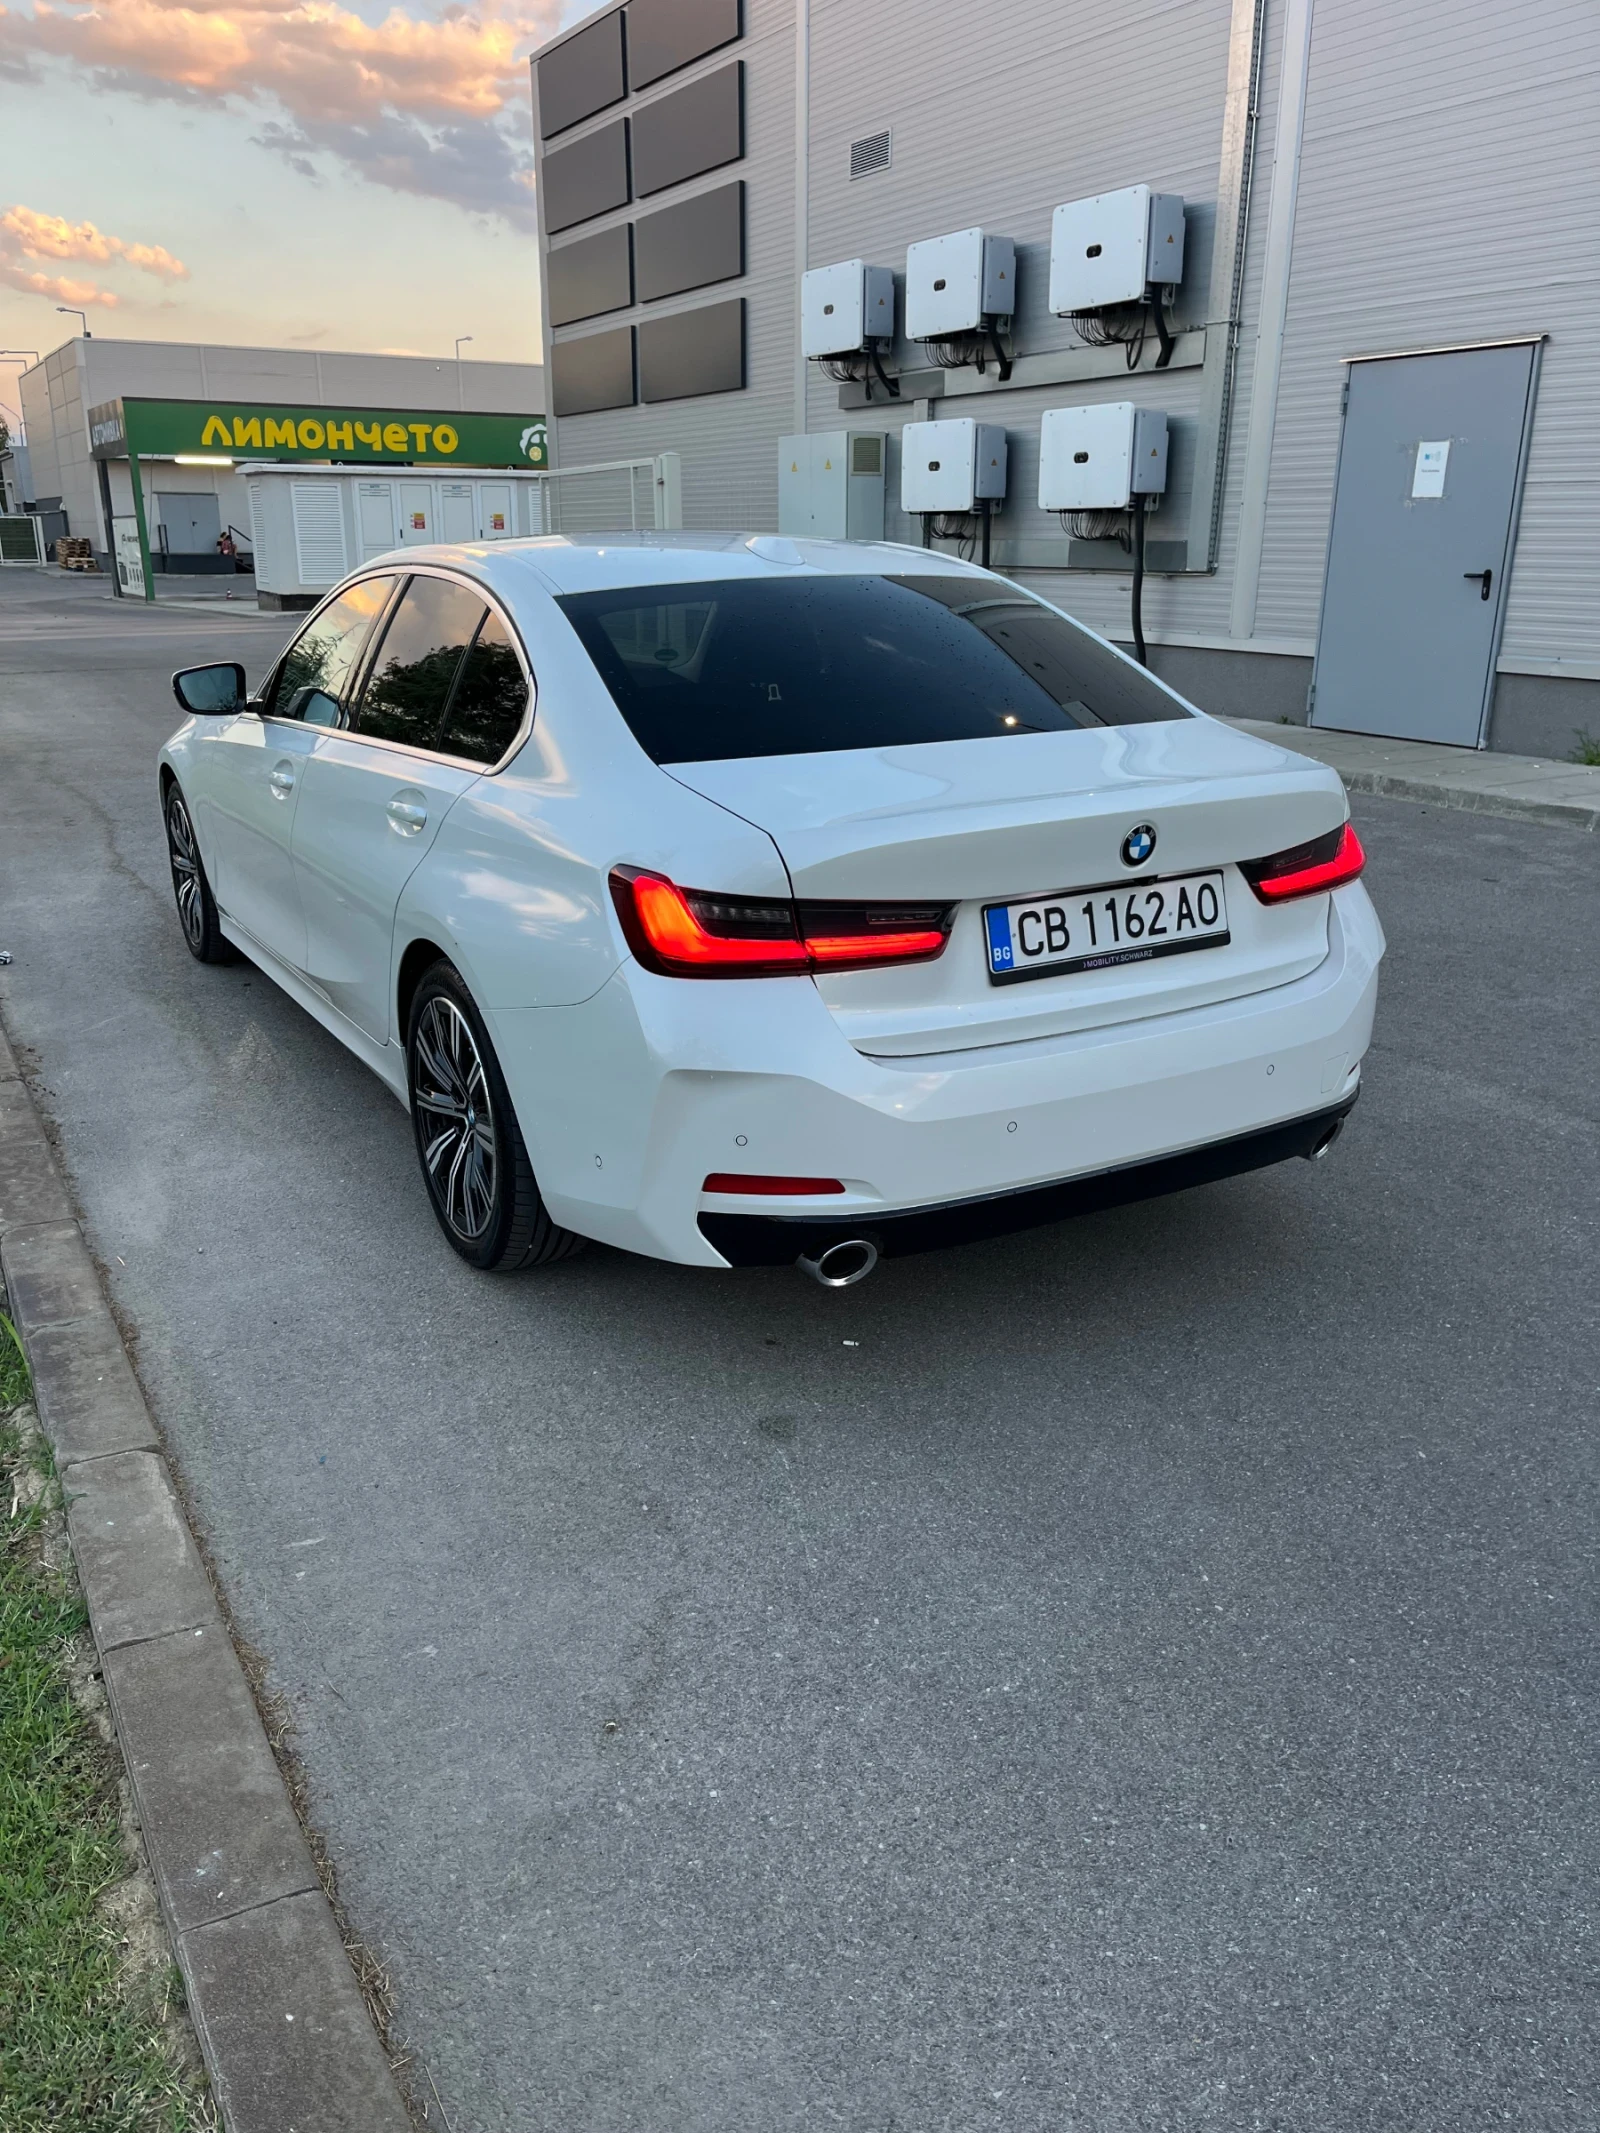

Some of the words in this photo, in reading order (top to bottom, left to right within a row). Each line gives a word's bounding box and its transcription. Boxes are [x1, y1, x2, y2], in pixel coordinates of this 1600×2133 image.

[1128, 825, 1155, 840] BMW
[1017, 906, 1071, 957] CB
[1082, 891, 1168, 946] 1162
[1176, 882, 1219, 932] AO
[993, 946, 1011, 962] BG
